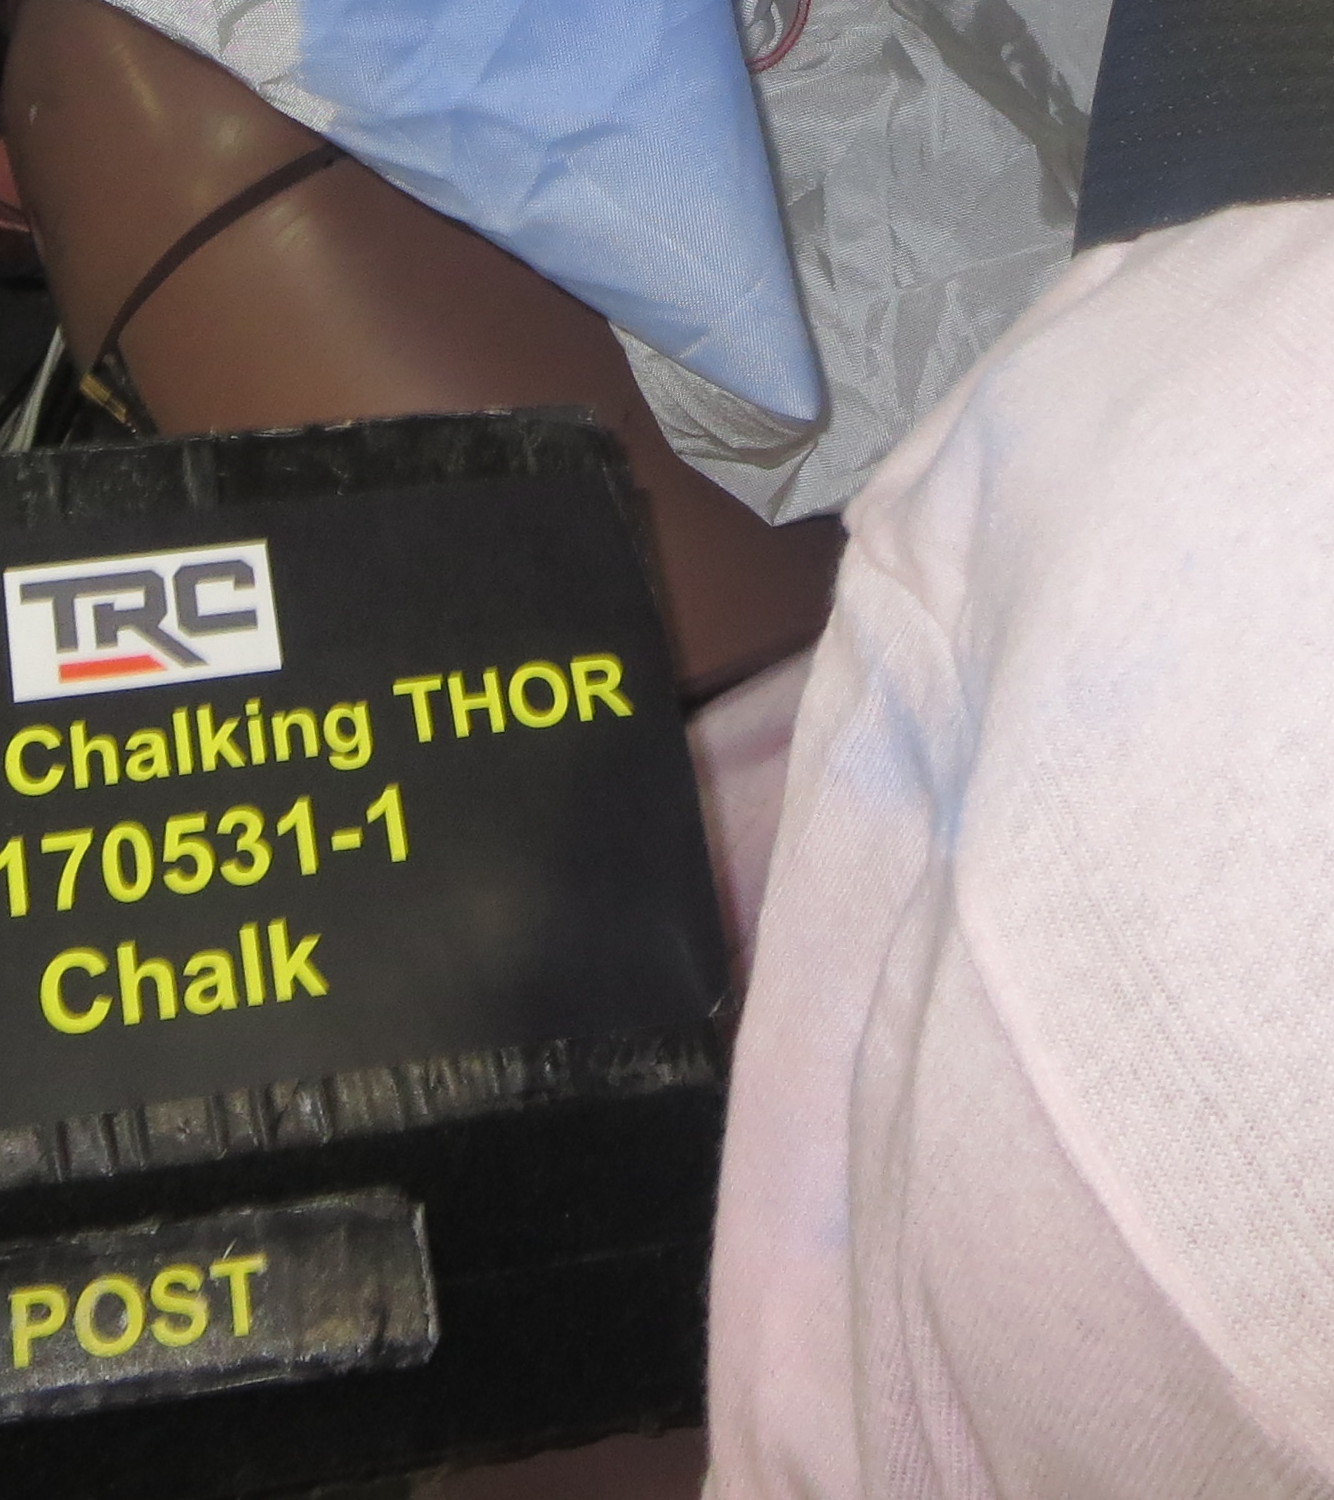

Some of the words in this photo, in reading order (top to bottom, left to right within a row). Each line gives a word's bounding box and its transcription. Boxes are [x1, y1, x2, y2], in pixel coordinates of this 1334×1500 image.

[20, 558, 259, 668] TRC
[2, 697, 376, 798] Chalking
[390, 653, 636, 744] THOR
[37, 917, 331, 1036] Chalk
[8, 1251, 270, 1370] POST
